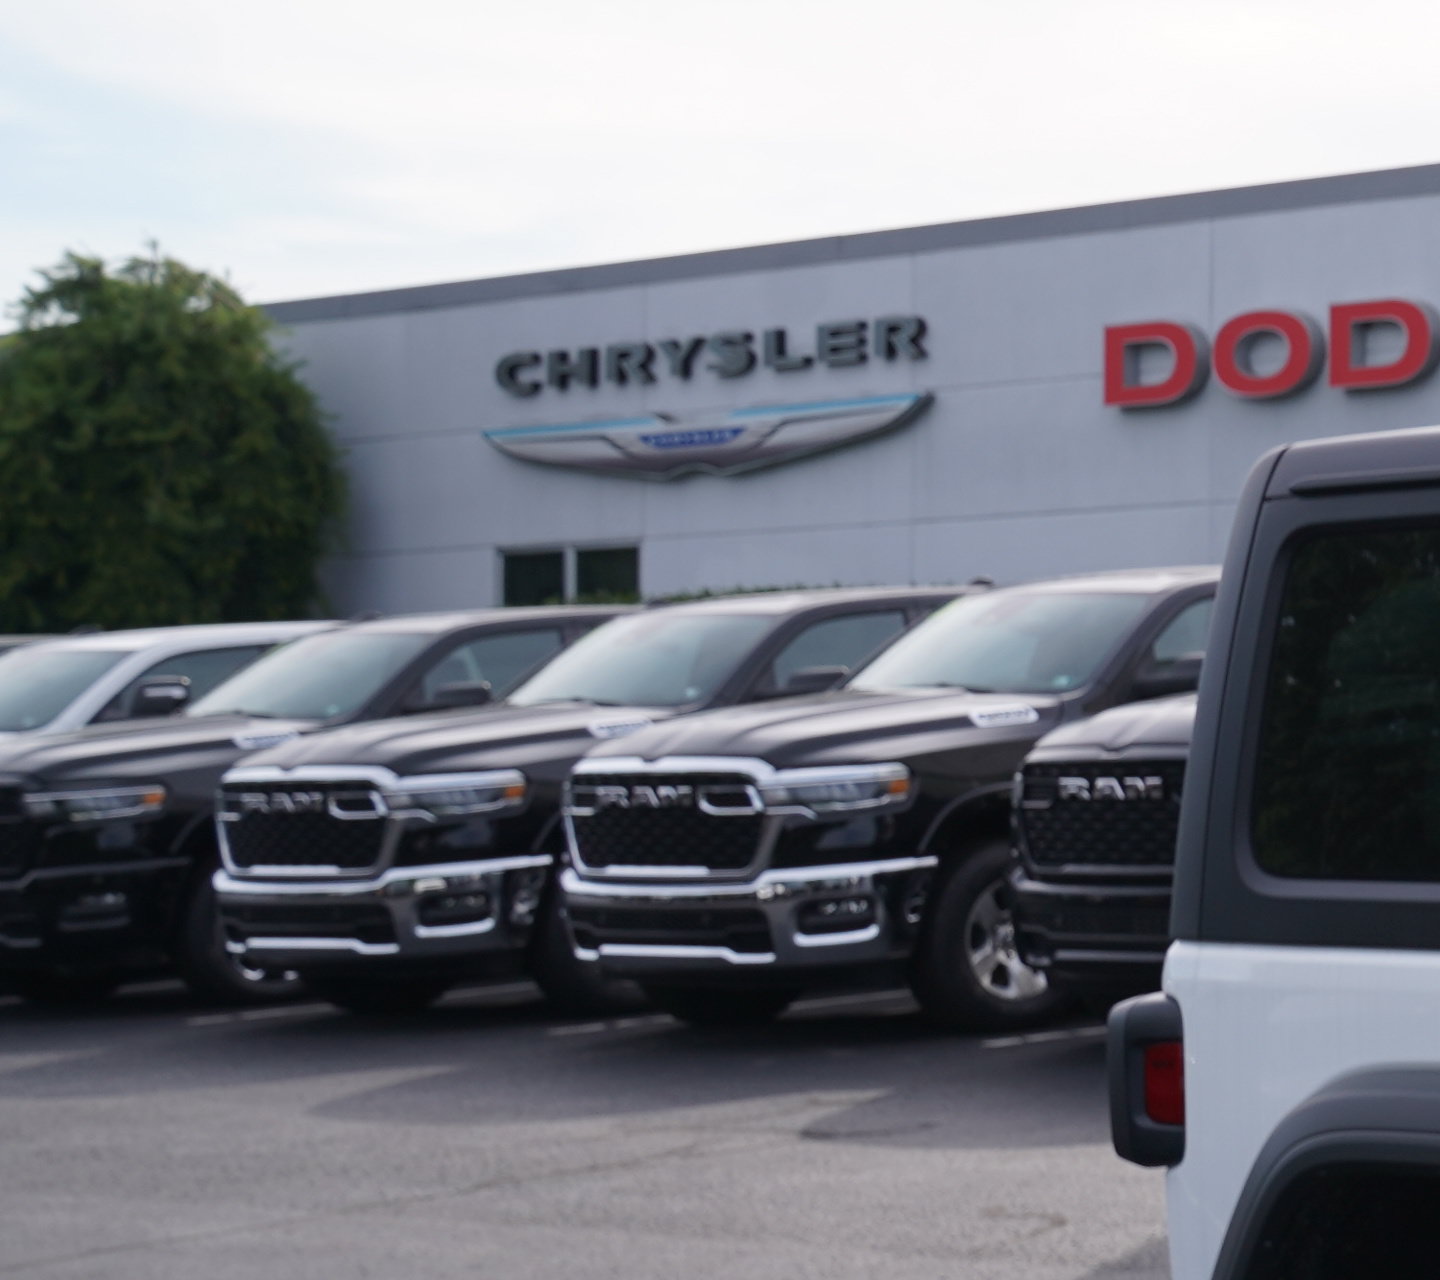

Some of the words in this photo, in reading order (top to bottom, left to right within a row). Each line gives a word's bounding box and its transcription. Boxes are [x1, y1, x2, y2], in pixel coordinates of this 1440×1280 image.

[495, 315, 930, 398] CHRYSLER
[600, 784, 693, 808] RAM
[1058, 776, 1163, 801] RAM
[241, 792, 323, 814] RAM
